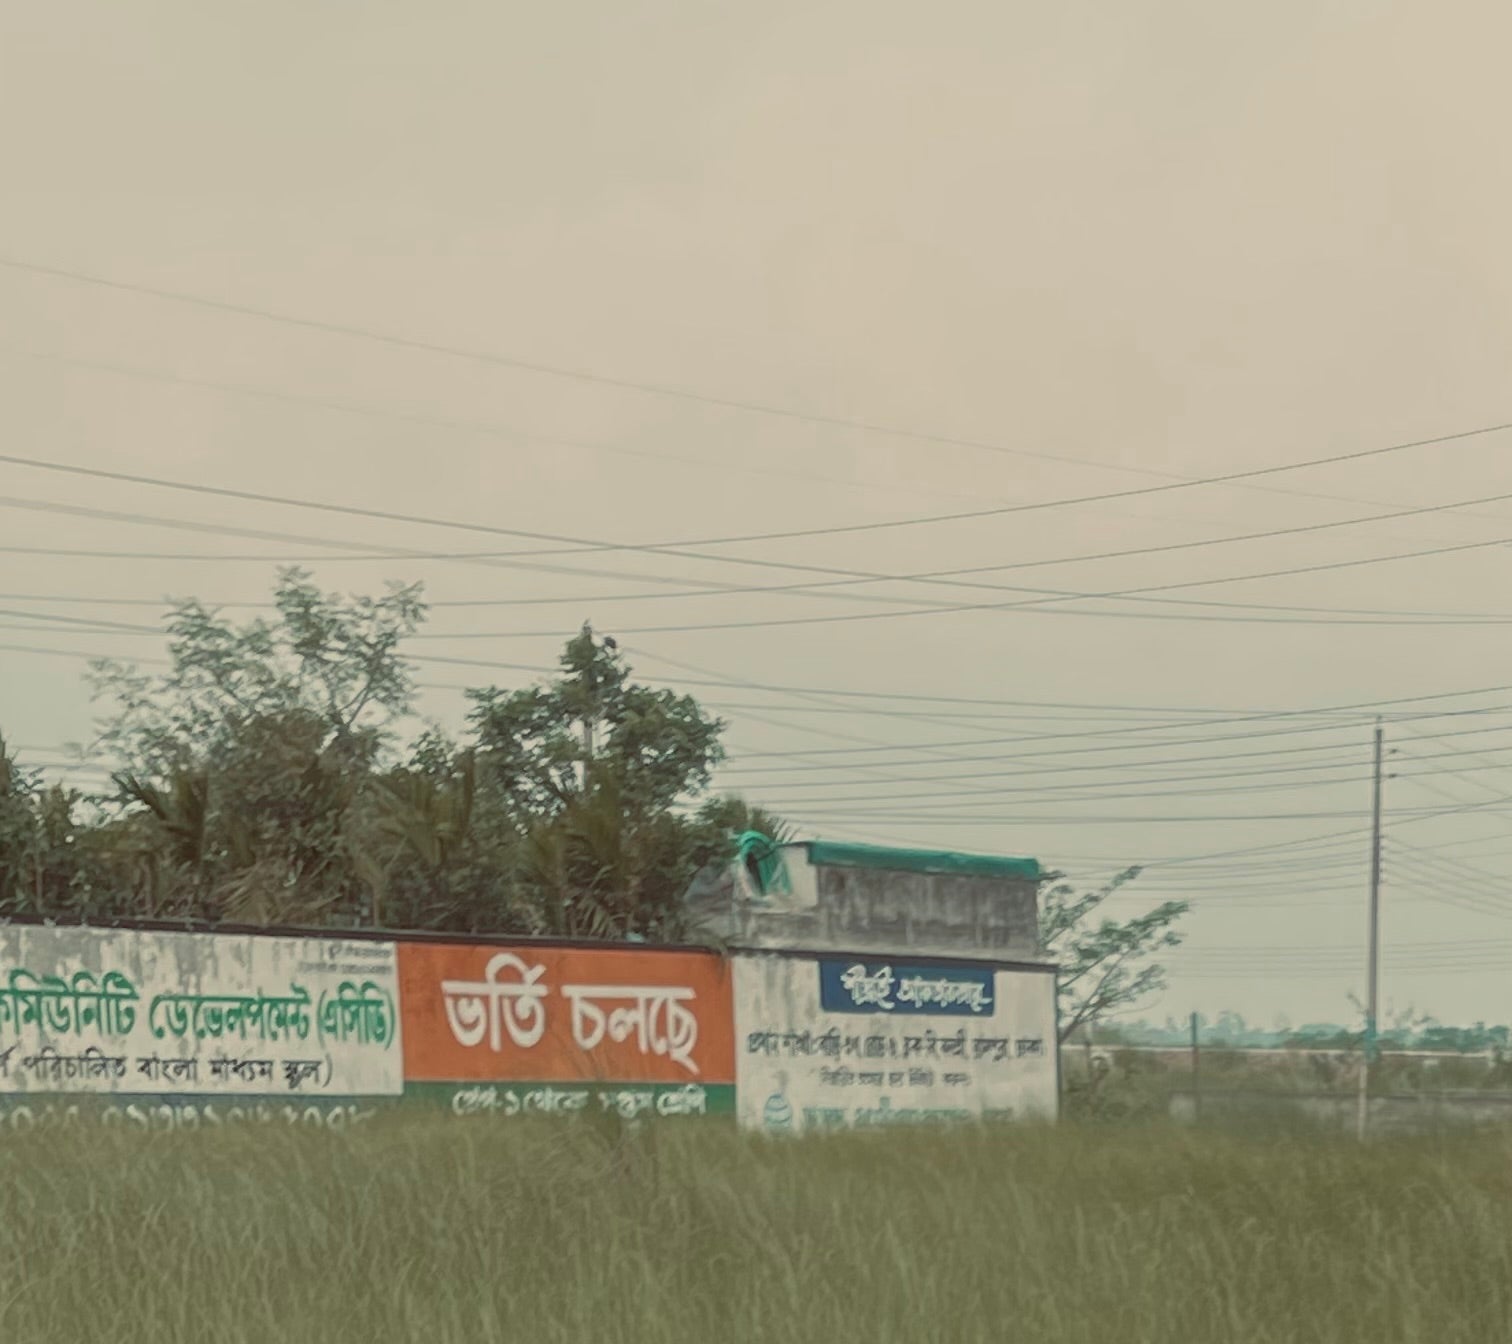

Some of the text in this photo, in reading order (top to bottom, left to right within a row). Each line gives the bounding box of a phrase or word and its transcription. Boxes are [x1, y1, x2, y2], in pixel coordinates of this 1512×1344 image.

[150, 982, 312, 1041] ডেভেলপমেন্ট
[441, 953, 698, 1075] ভর্তি চলছে
[22, 1046, 127, 1081] পরিচালিত
[137, 1053, 198, 1082] বাংলা
[208, 1054, 273, 1083] মাধ্যম
